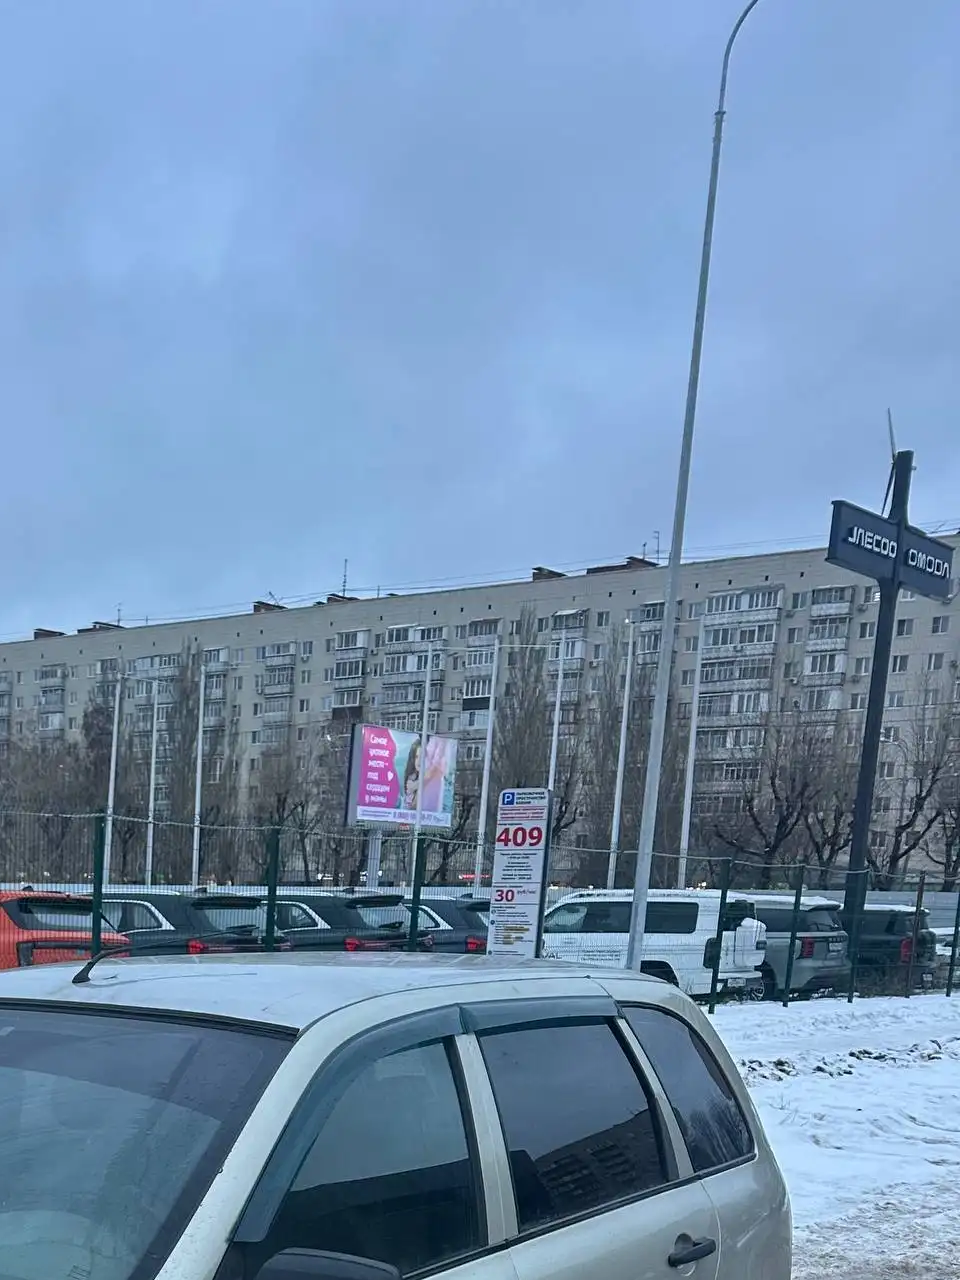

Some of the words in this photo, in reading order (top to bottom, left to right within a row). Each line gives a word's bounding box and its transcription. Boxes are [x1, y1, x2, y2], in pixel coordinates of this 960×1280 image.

[847, 526, 898, 559] JAECOO
[907, 548, 950, 579] OMODA
[496, 826, 543, 847] 409
[494, 889, 515, 902] 30
